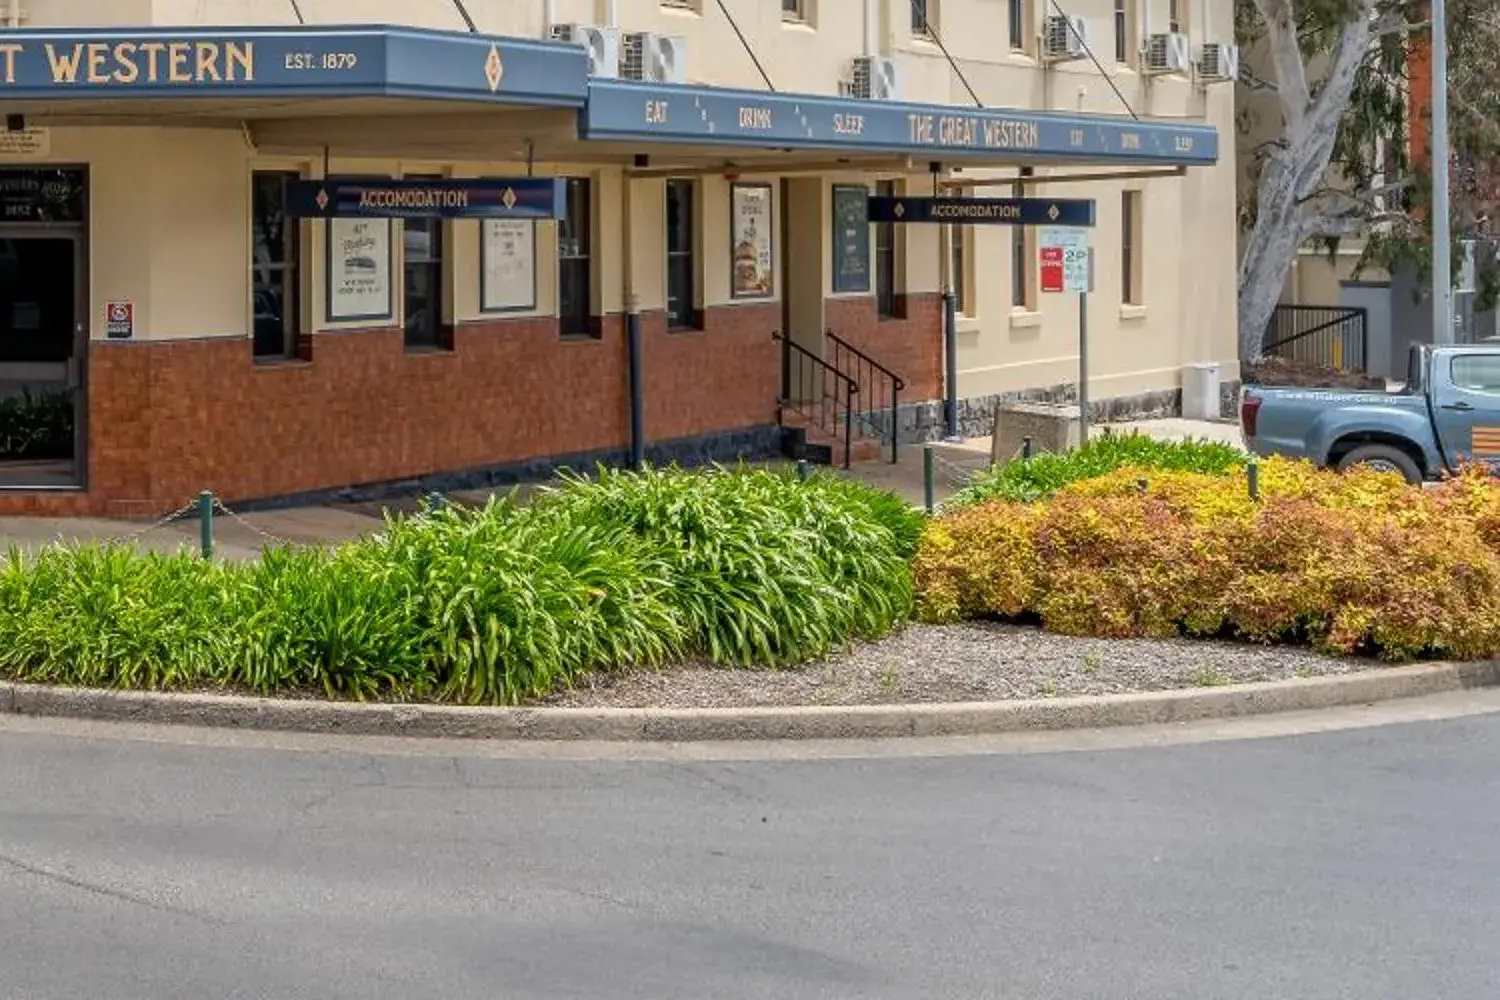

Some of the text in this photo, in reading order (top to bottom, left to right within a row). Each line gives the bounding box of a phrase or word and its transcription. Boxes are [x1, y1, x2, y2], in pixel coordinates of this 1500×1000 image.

[43, 41, 255, 83] WESTERN
[284, 52, 357, 69] EST. 1879
[645, 101, 668, 123] EAT
[739, 107, 772, 128] DRINK
[909, 114, 1040, 149] THE GREAT WESTERN
[359, 190, 468, 208] ACCOMODATION
[931, 204, 1021, 218] ACCOMODATION
